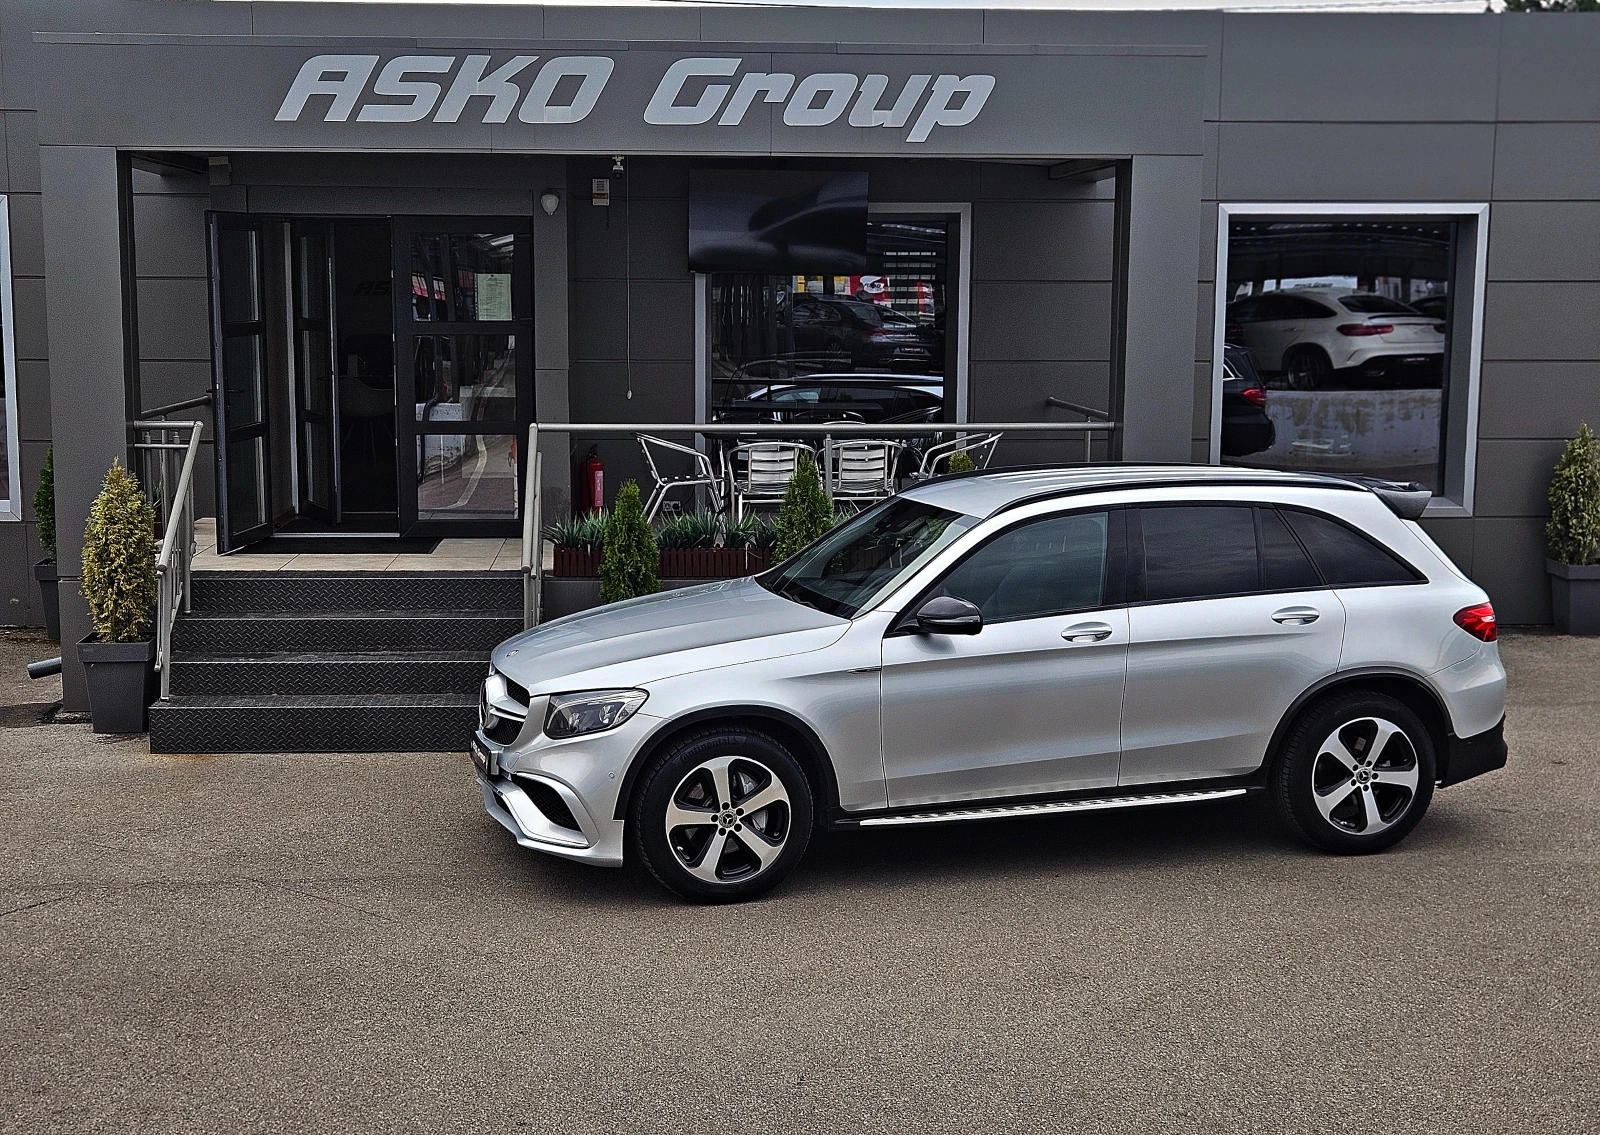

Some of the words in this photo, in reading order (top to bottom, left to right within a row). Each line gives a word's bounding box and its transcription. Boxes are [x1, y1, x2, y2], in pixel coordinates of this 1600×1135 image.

[274, 54, 615, 125] ASKO
[643, 57, 996, 143] Group
[353, 280, 391, 297] AS
